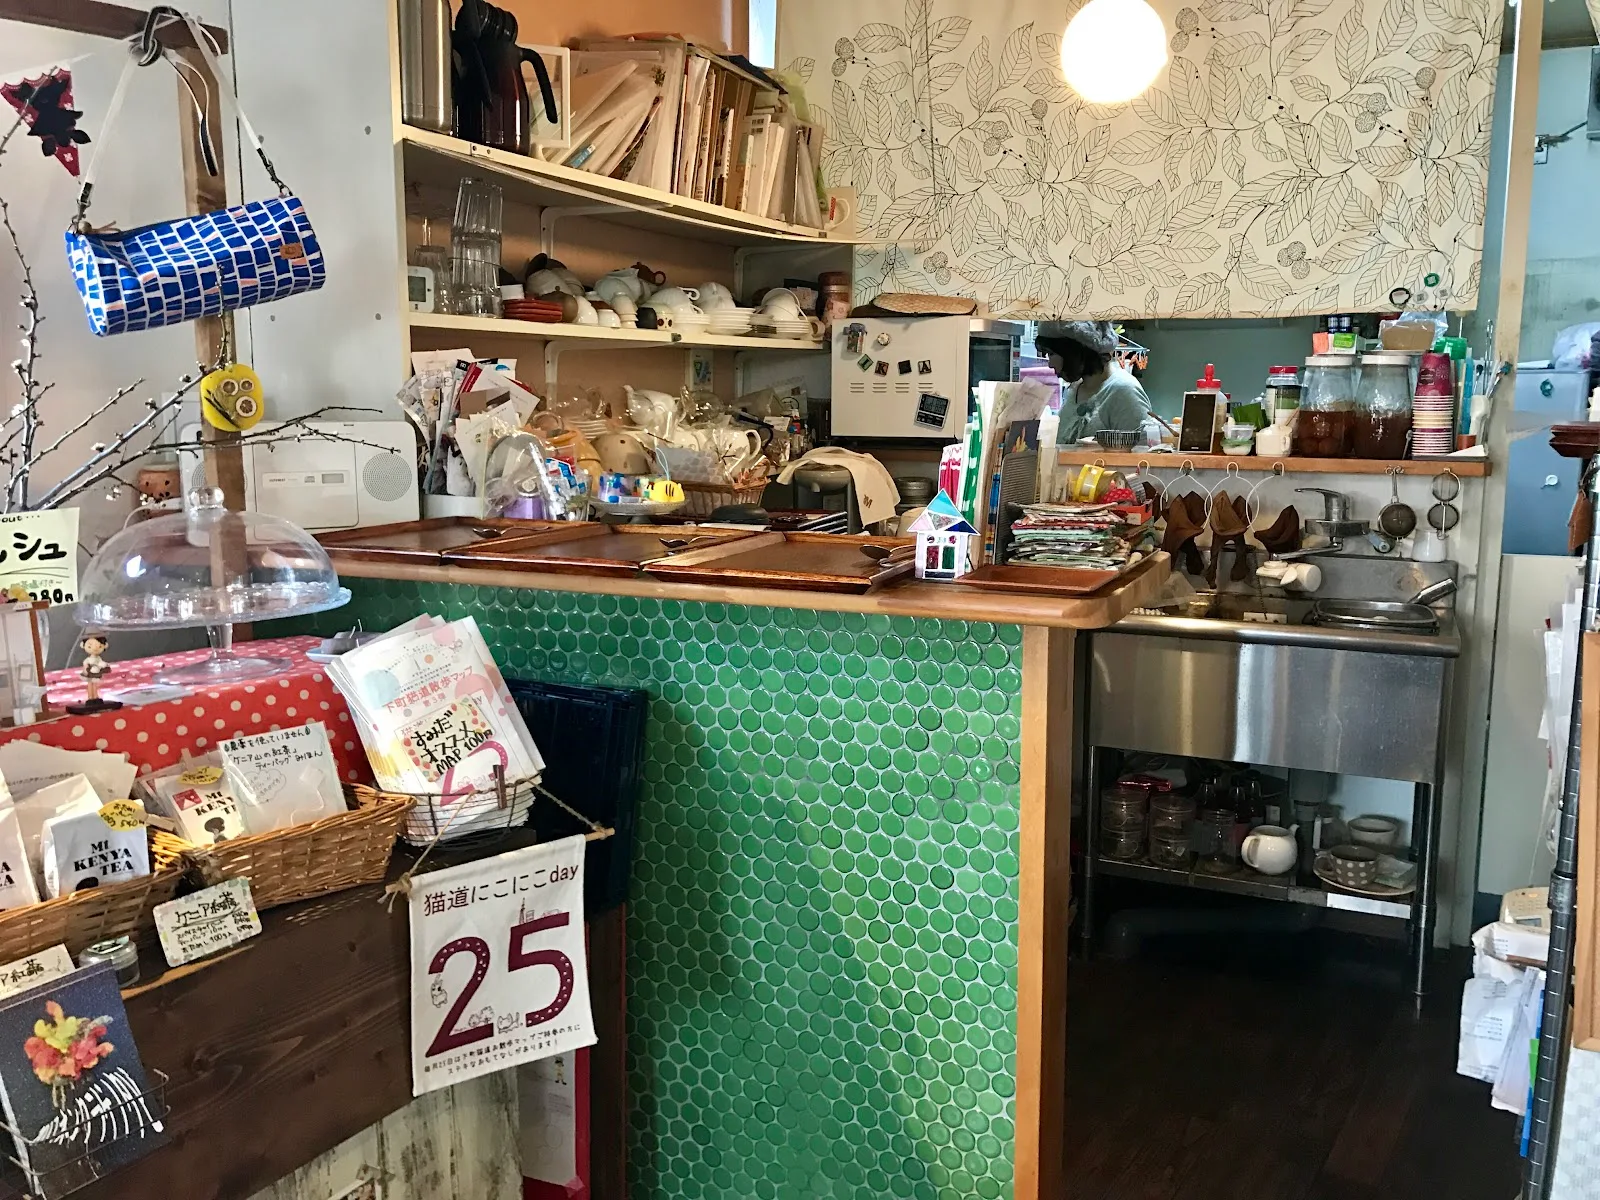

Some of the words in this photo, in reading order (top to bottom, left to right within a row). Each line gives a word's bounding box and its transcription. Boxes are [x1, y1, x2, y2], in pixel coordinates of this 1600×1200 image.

[0, 532, 67, 563] シュ
[420, 720, 475, 764] オススメ
[436, 748, 461, 775] MAP
[74, 848, 132, 872] KENYA
[100, 861, 133, 876] TEA
[425, 912, 574, 1058] 25
